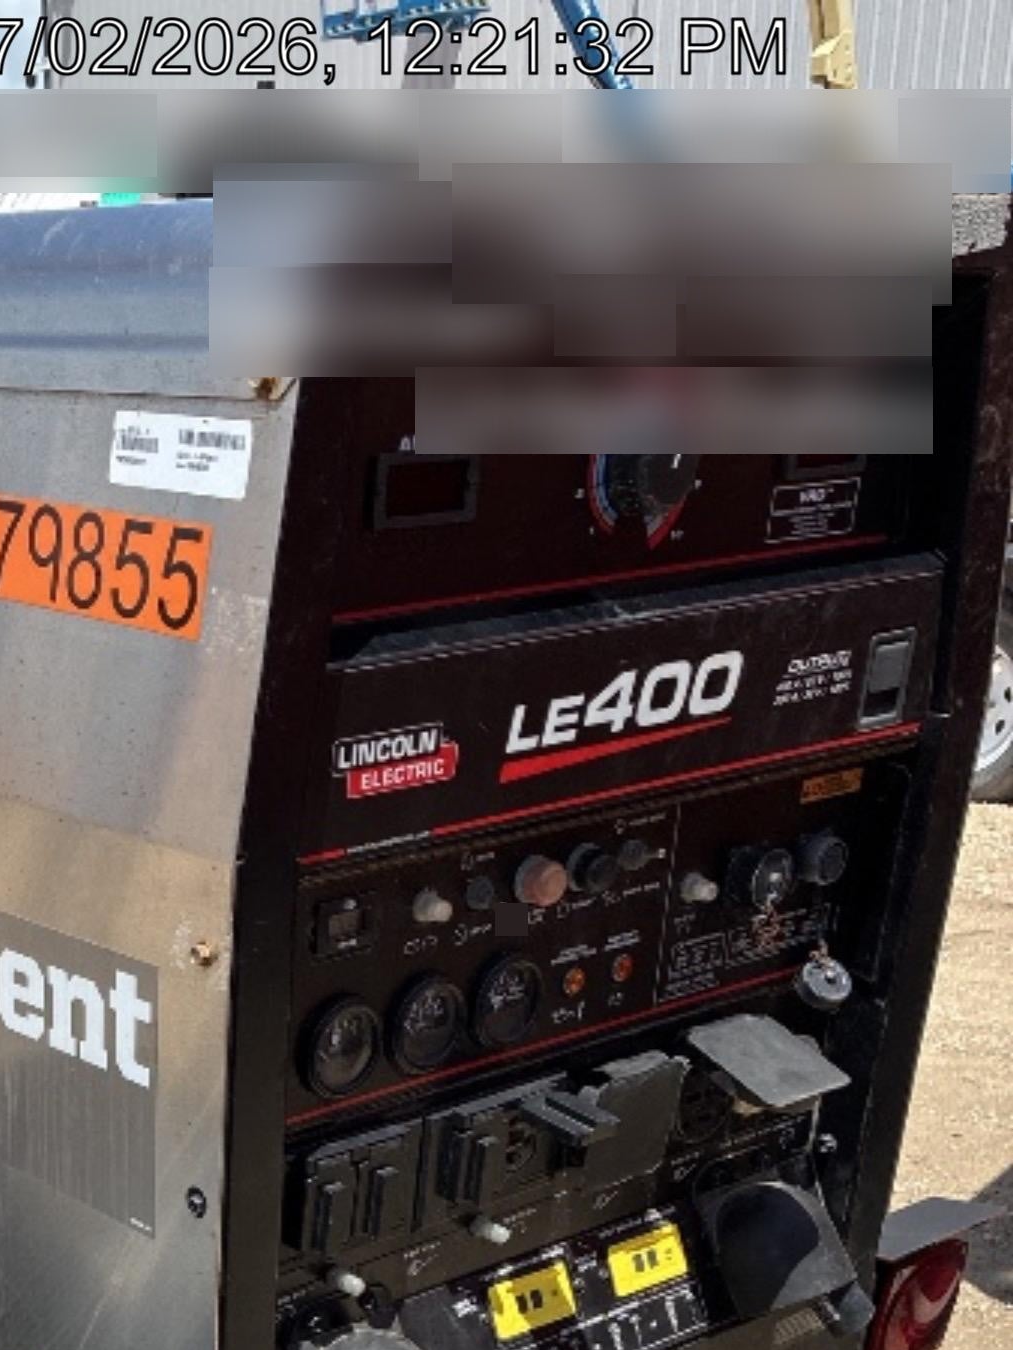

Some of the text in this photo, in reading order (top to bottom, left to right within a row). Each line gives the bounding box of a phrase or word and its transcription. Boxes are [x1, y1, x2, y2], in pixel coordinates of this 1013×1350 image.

[506, 650, 745, 754] LE400
[336, 727, 440, 770] LINCOLN
[360, 757, 446, 791] ELECTRIC
